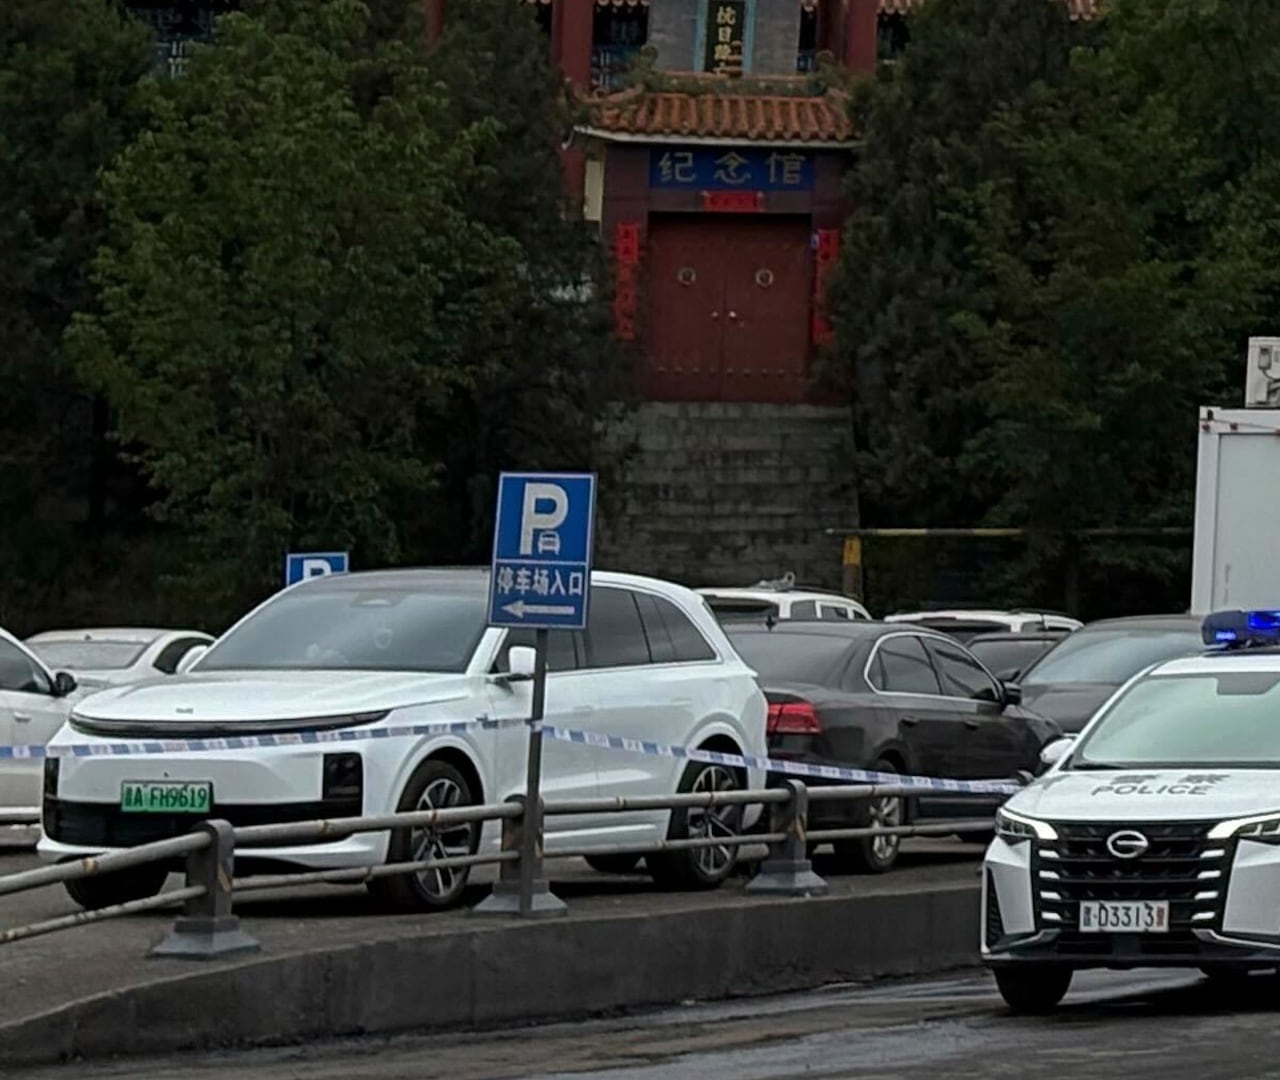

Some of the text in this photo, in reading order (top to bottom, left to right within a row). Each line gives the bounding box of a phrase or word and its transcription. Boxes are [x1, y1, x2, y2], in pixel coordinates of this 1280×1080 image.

[659, 152, 806, 184] 纪念馆
[520, 482, 568, 555] P
[498, 567, 583, 596] 停车场入口
[1091, 785, 1213, 796] POLICE
